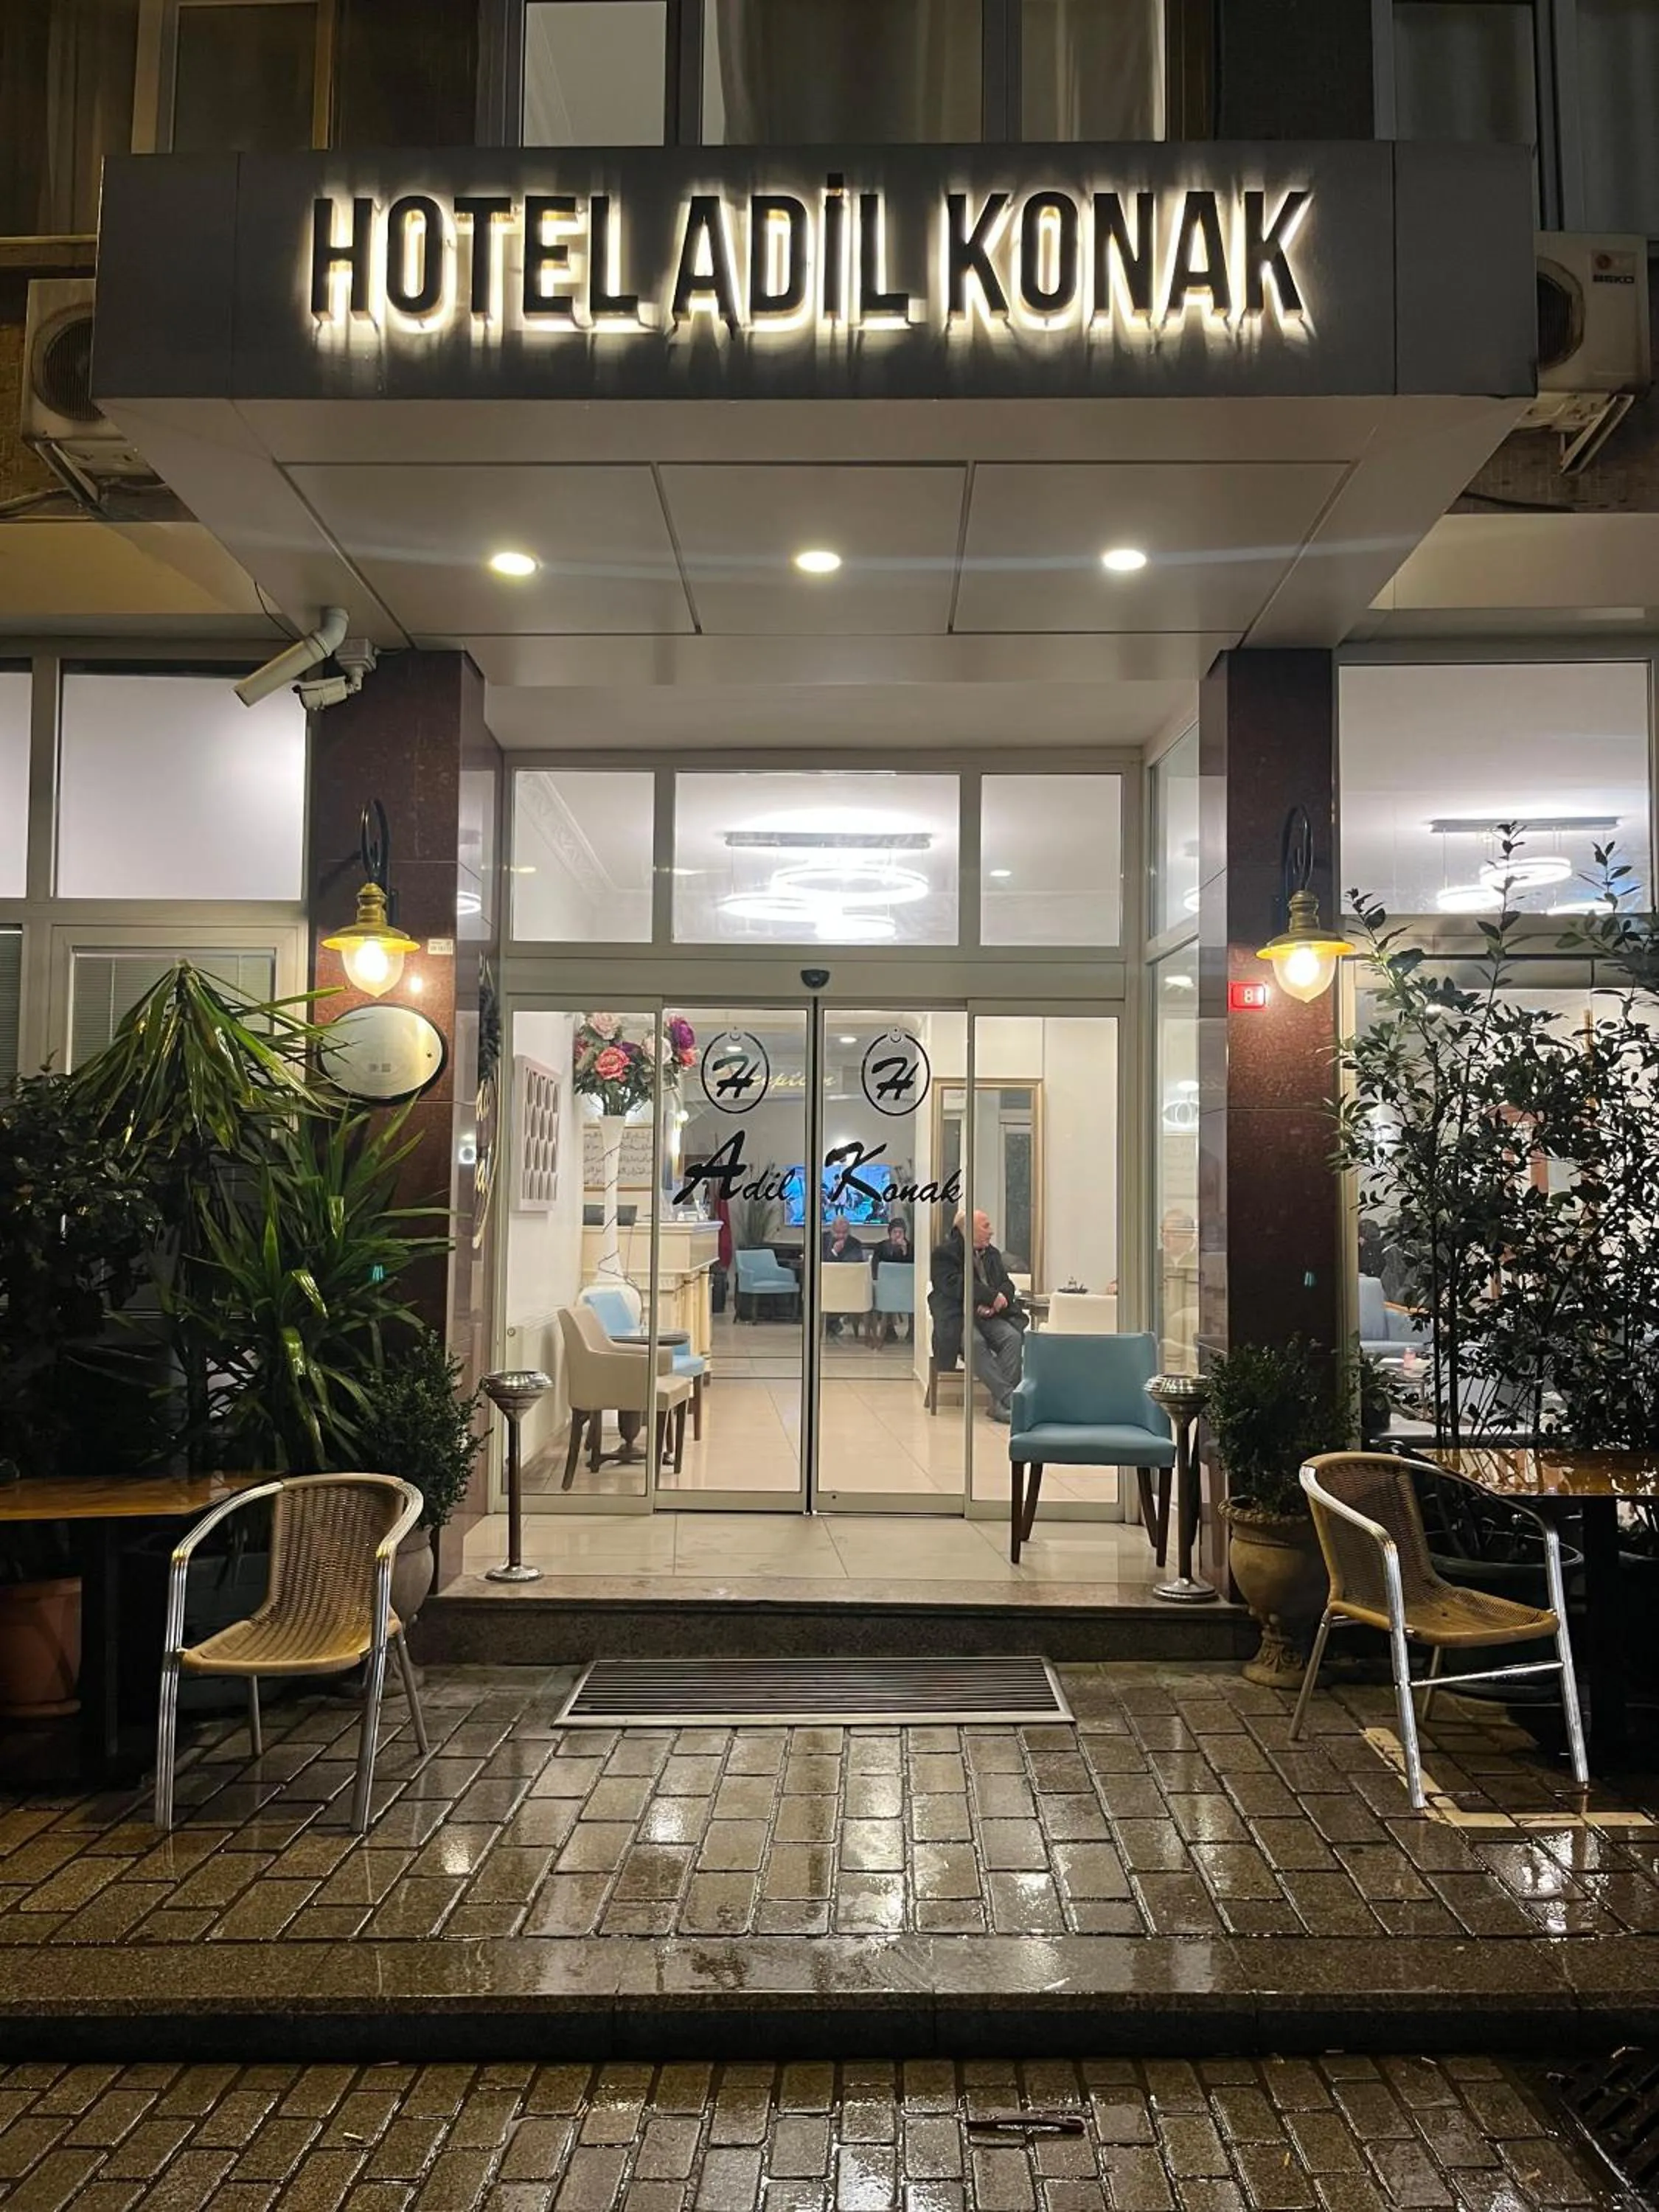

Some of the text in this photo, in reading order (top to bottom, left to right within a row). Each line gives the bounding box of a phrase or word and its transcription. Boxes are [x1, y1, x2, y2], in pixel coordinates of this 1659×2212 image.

[311, 173, 1311, 329] HOTEL ADİL KONAK
[1244, 989, 1254, 1004] 8
[712, 1055, 760, 1099] H
[872, 1057, 919, 1100] H
[672, 1130, 796, 1206] Adil
[825, 1141, 963, 1205] Konak
